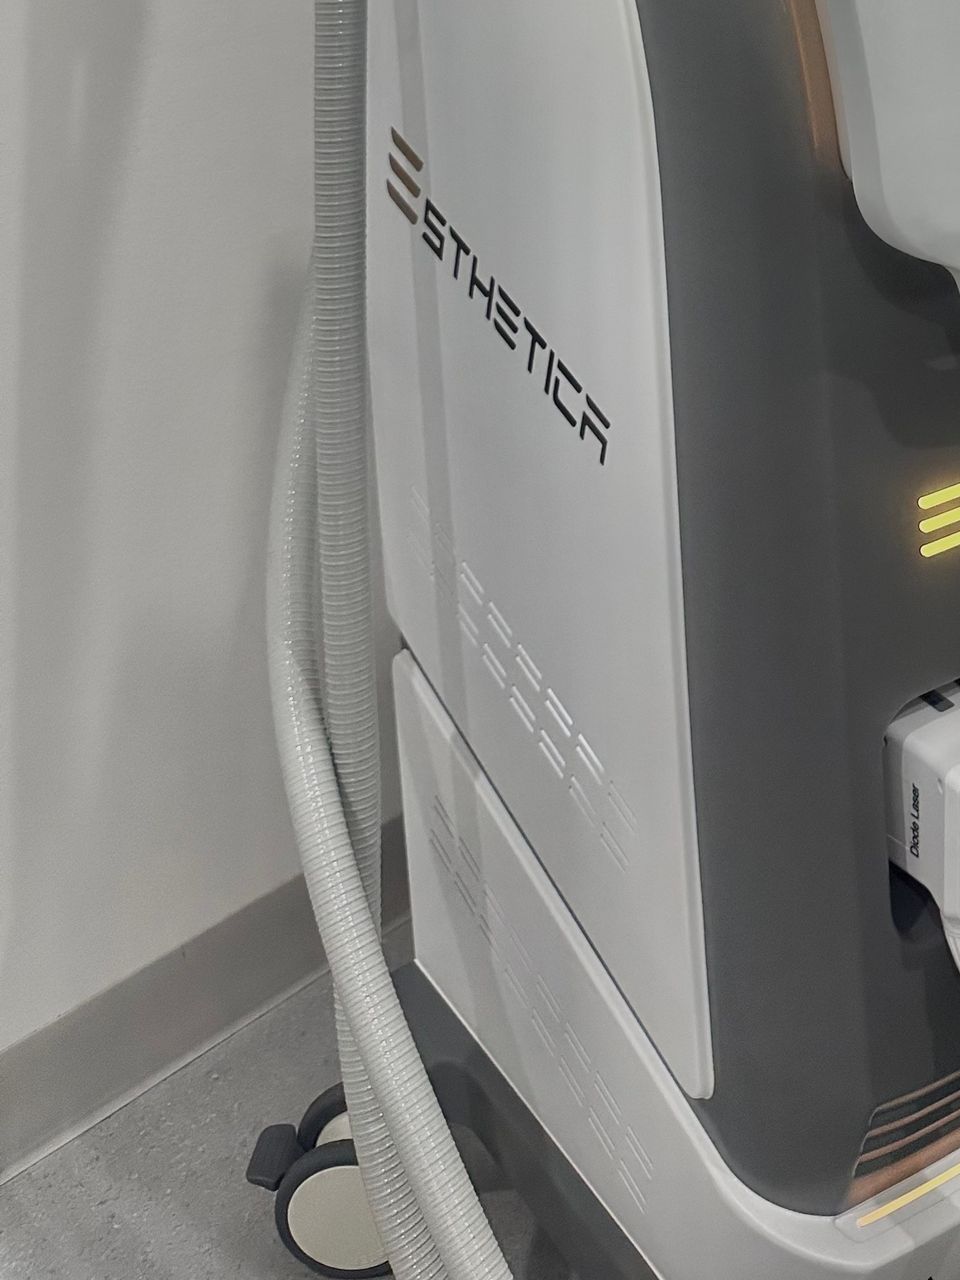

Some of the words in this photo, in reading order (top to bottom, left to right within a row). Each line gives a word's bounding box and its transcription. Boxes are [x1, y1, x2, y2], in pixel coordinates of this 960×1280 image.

[386, 125, 611, 466] ESTHETICA
[910, 782, 920, 820] Laser
[909, 821, 920, 858] Diode
